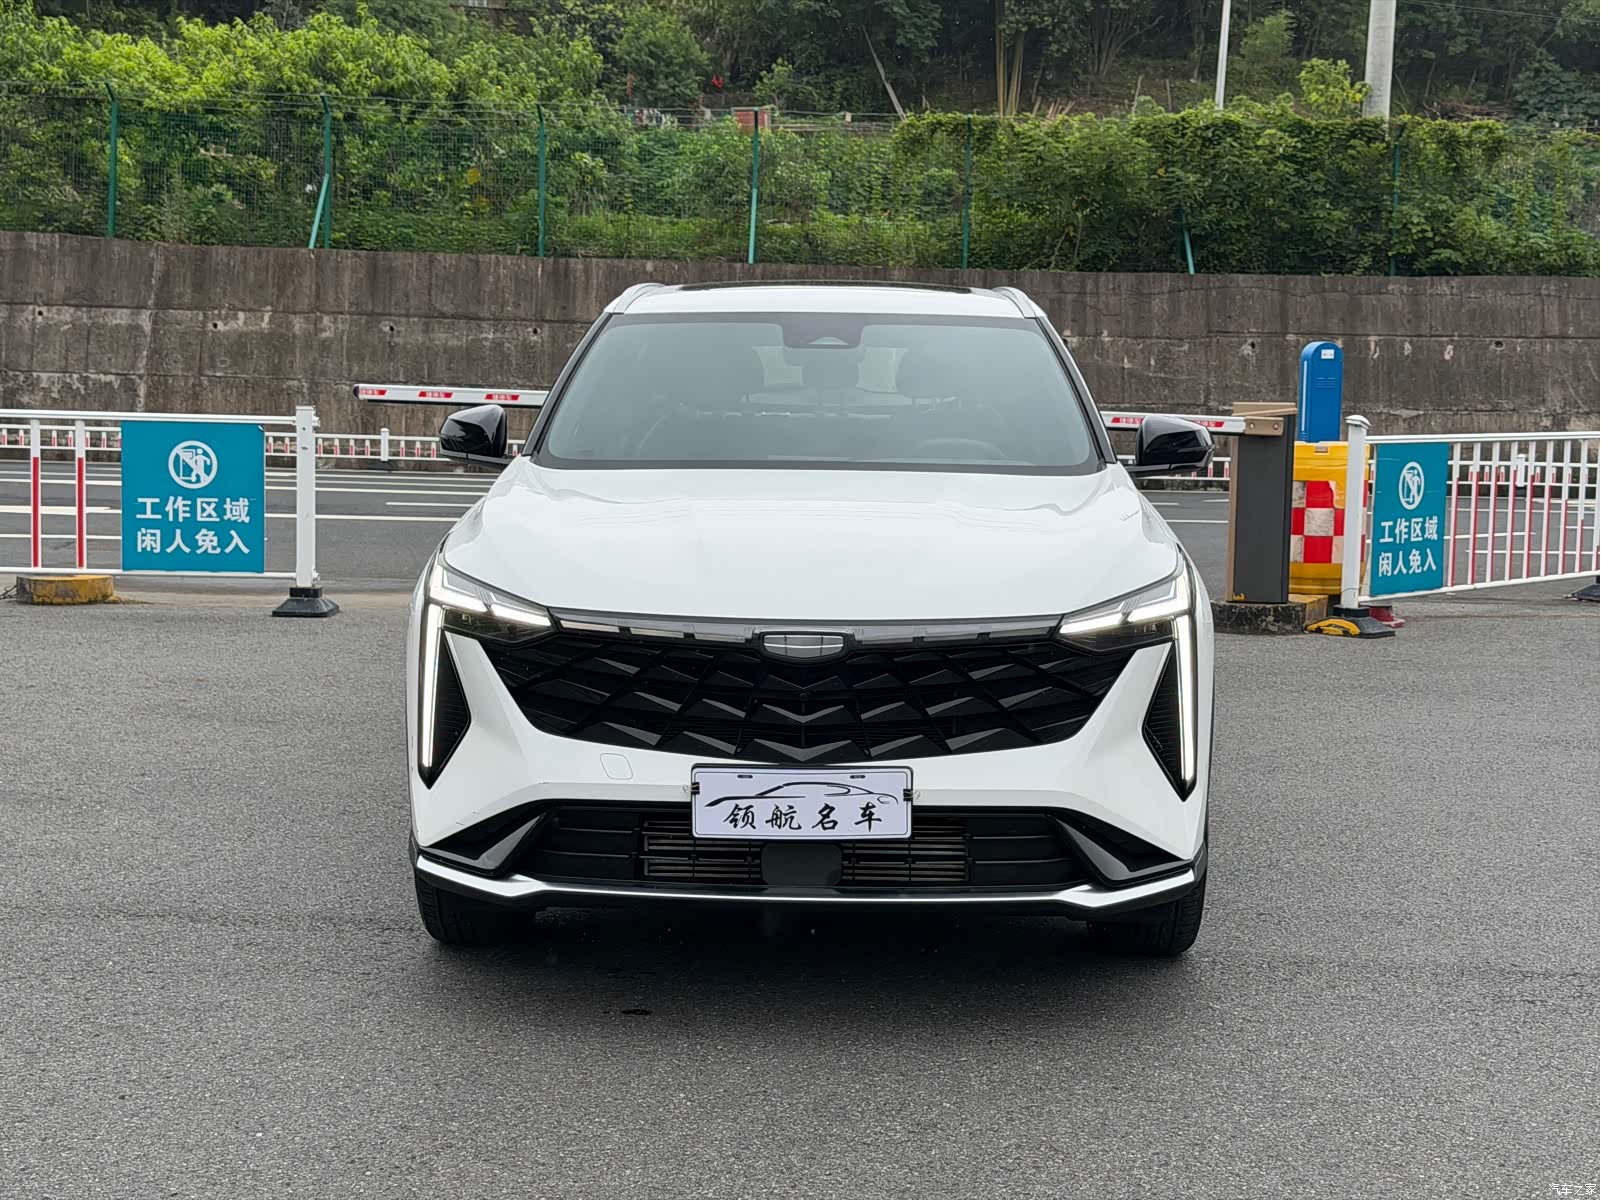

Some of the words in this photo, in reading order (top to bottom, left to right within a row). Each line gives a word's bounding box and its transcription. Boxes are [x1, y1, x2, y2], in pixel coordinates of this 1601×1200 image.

[136, 496, 250, 523] 工作区域
[137, 528, 250, 554] 闲人免入
[1379, 515, 1438, 544] 工作区域
[1378, 547, 1437, 577] 闲人免入
[723, 801, 882, 833] 领航名车
